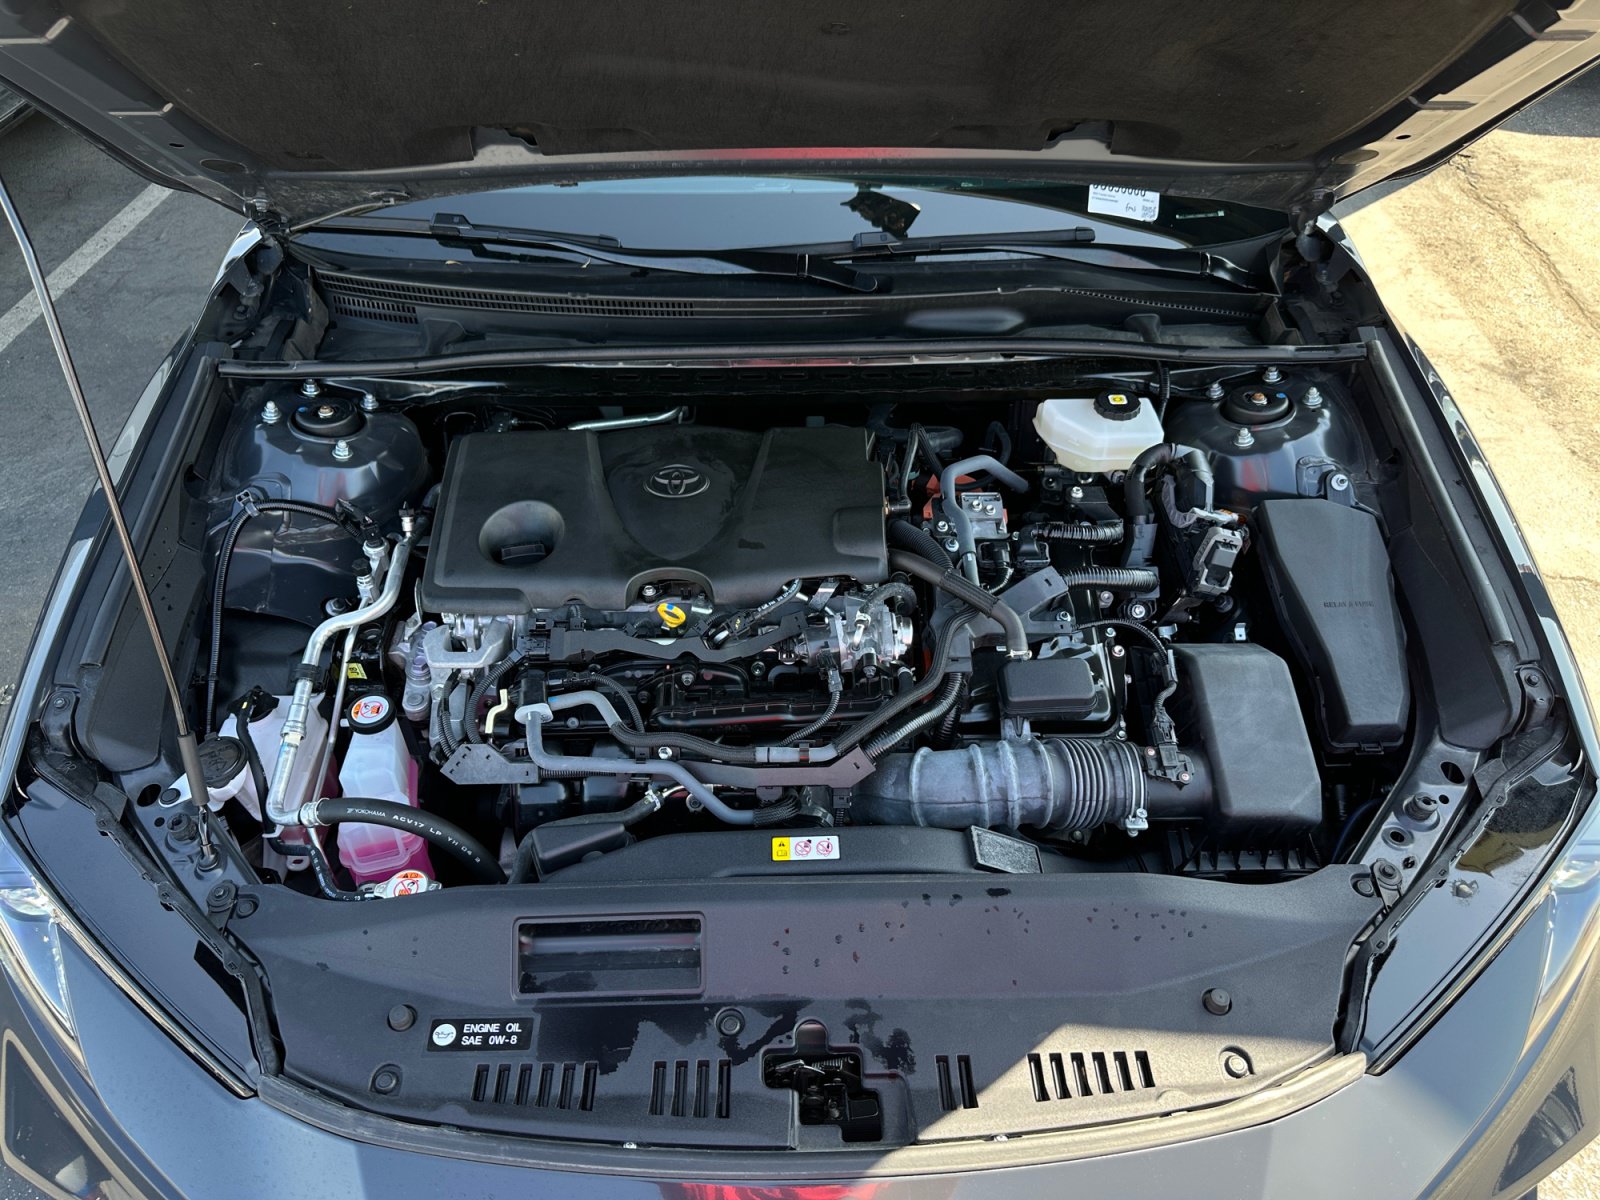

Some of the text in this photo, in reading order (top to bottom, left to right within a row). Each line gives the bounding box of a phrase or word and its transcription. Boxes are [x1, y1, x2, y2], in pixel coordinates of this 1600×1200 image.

[354, 808, 386, 817] YOKOHAMA
[392, 814, 425, 828] ACV17
[463, 1022, 522, 1033] ENGINE OIL
[461, 1035, 518, 1045] SAE 0W-8
